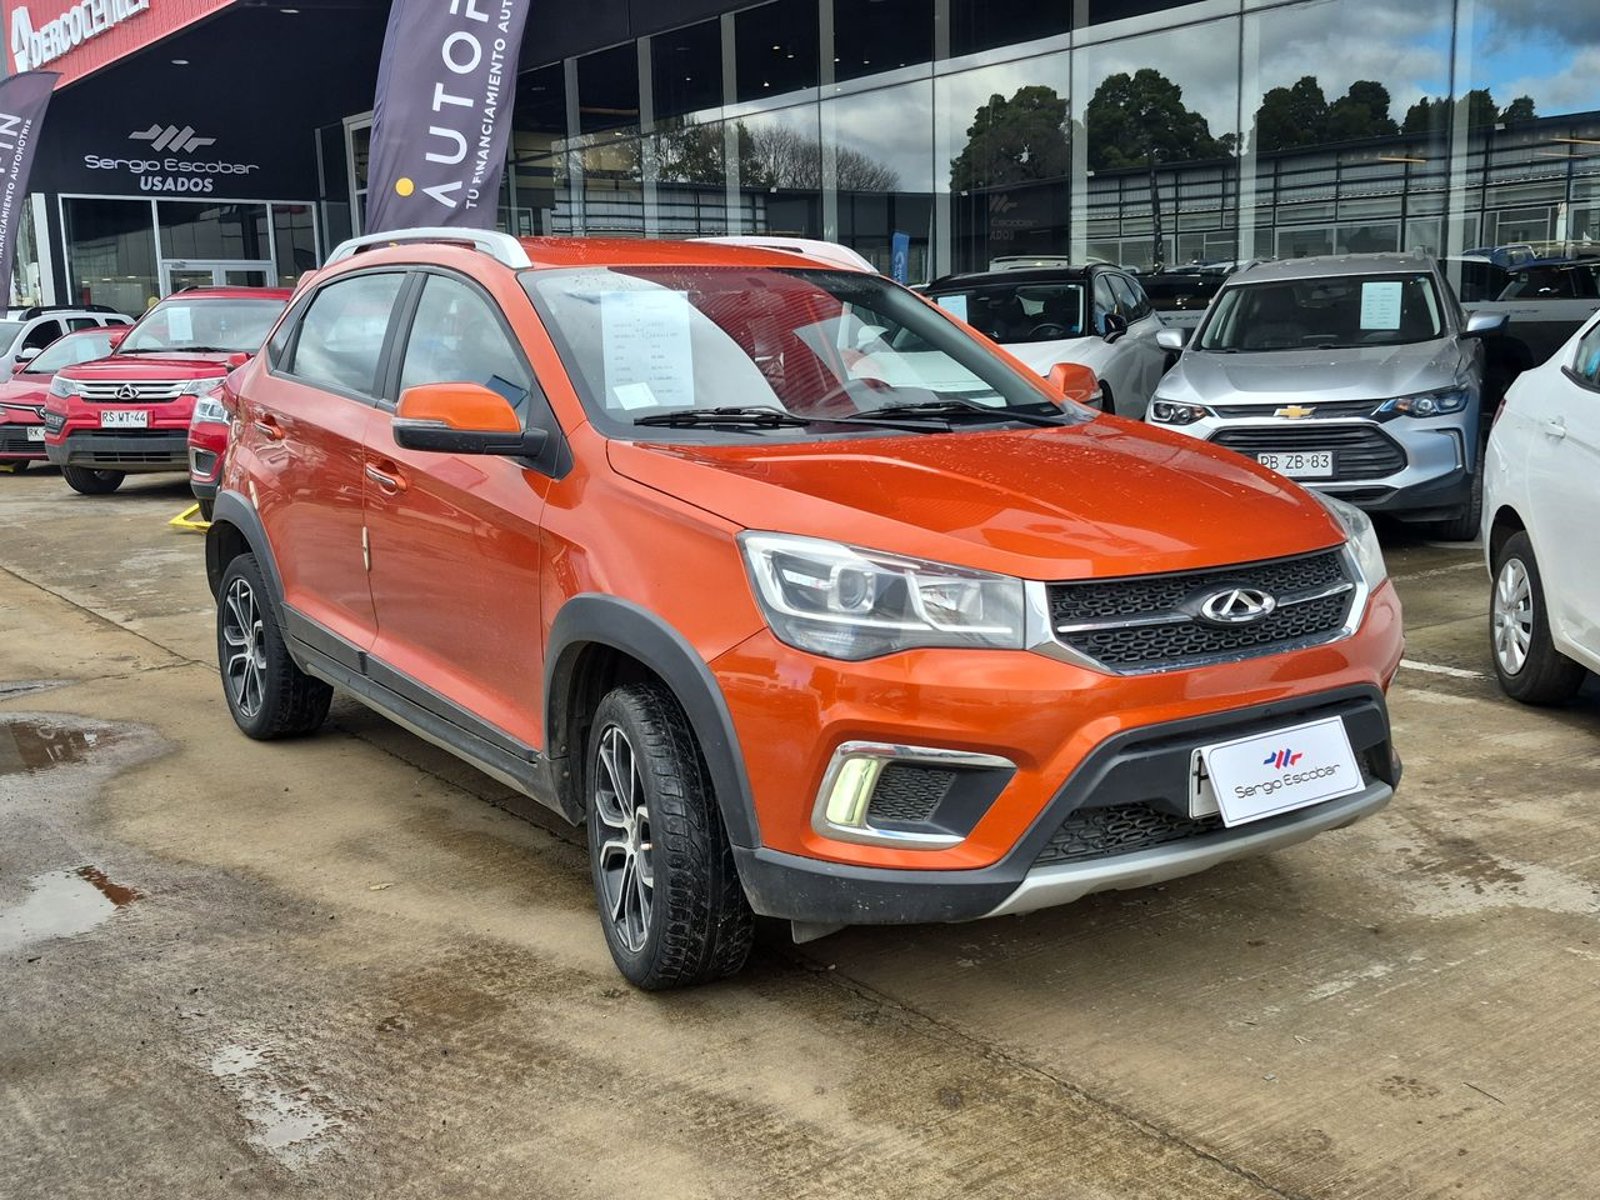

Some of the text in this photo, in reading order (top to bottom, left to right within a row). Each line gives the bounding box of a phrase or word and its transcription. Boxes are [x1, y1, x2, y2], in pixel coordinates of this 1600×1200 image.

[30, 0, 149, 68] DERCOCEN
[472, 38, 506, 184] FINANCIAMIENTO
[10, 119, 32, 180] AUTOMOTRIZ
[84, 155, 260, 174] Sergio Escobar
[140, 176, 214, 192] USADOS
[466, 189, 480, 209] TU
[1283, 764, 1341, 786] Escobar
